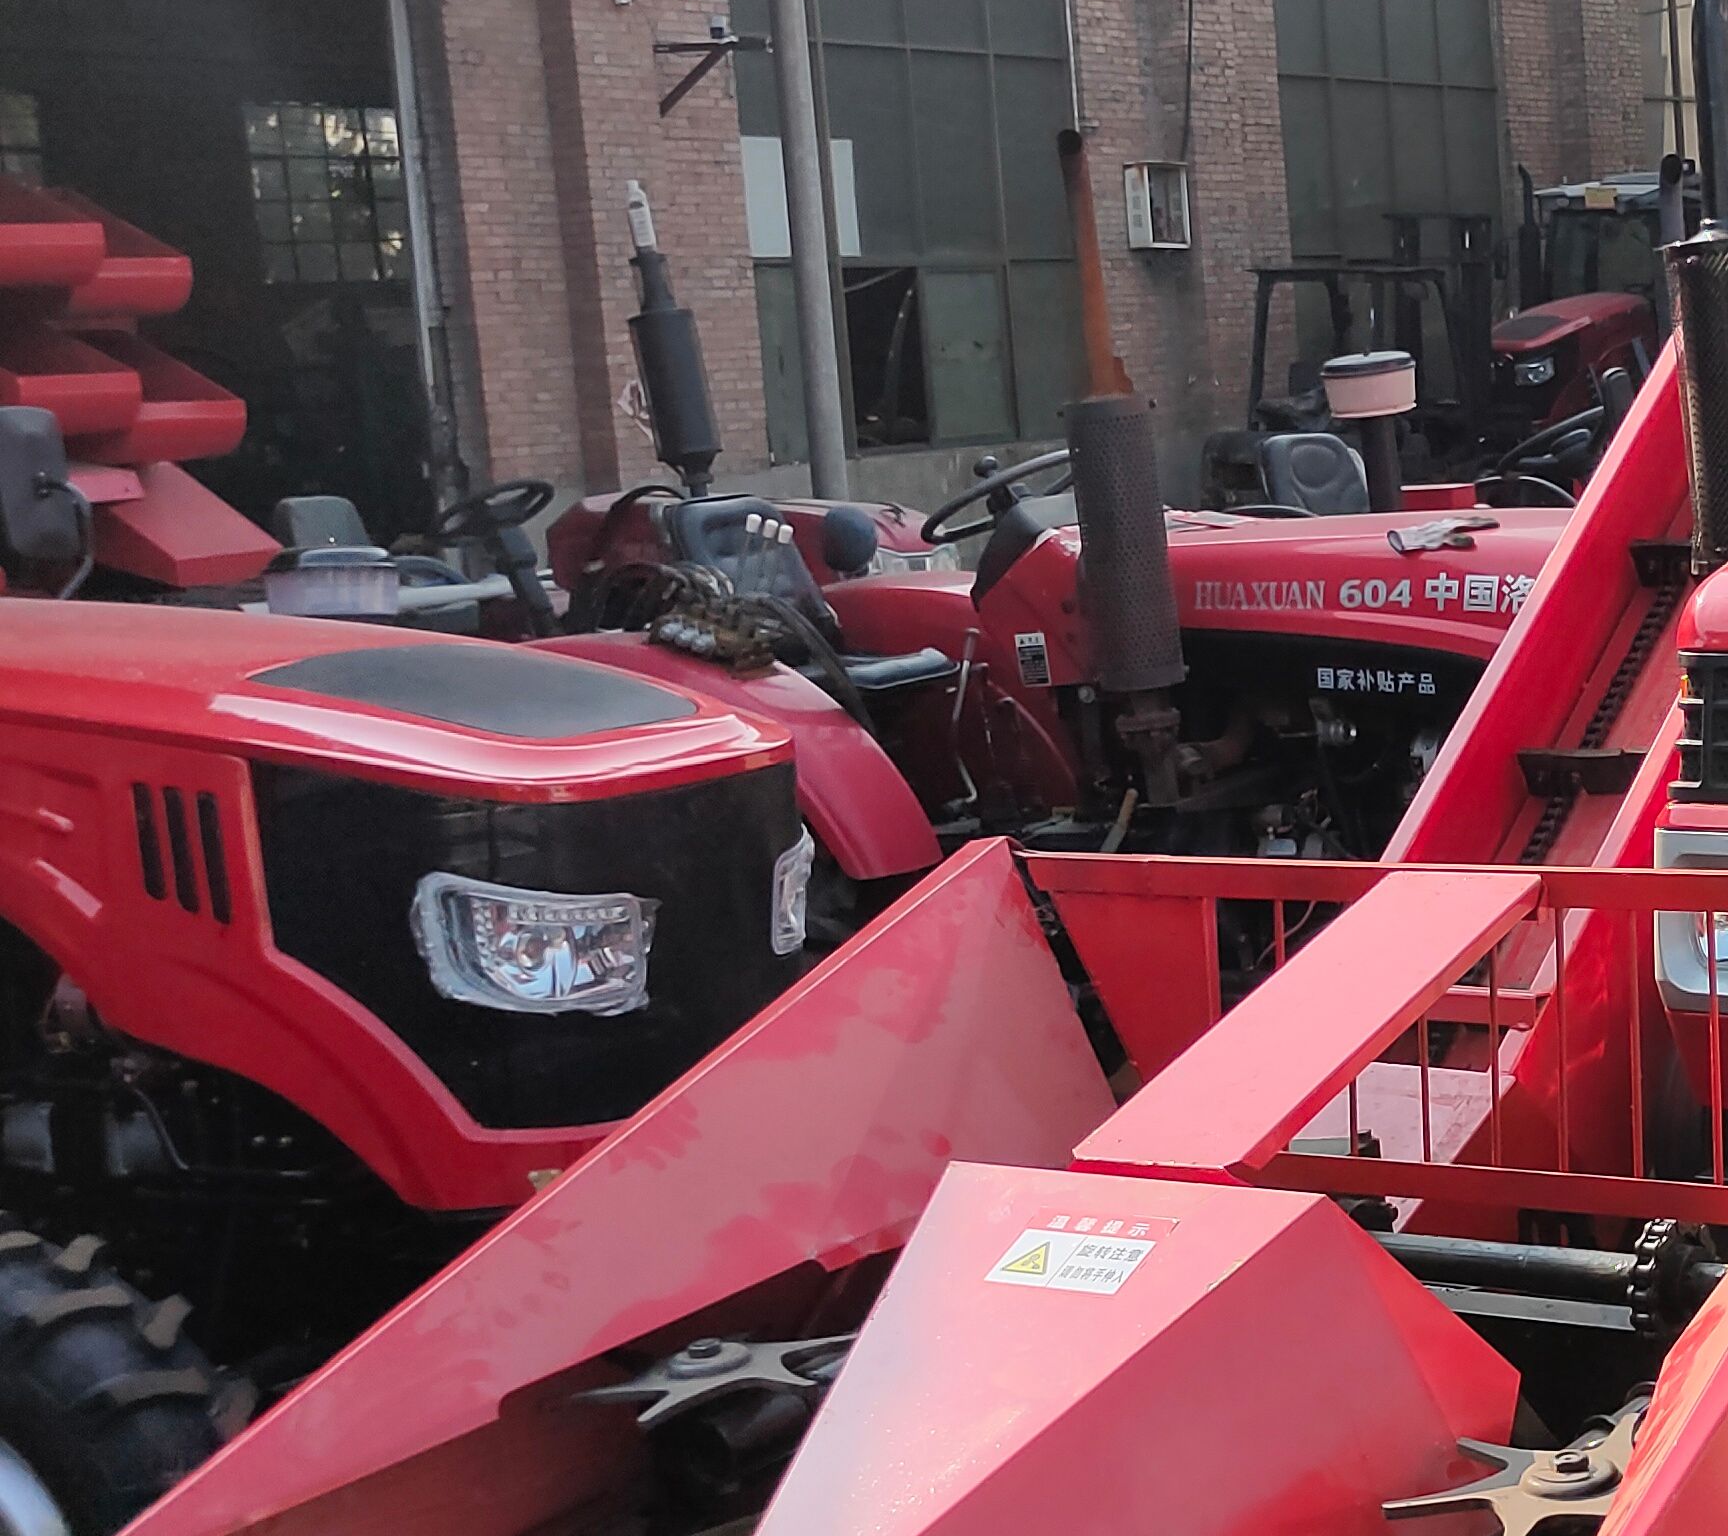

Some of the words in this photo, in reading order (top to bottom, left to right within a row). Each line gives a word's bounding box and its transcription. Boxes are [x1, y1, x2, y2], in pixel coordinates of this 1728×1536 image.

[1194, 579, 1326, 611] HUAXUAN
[1338, 578, 1412, 609] 604
[1317, 667, 1436, 695] 国家补贴产品
[1046, 1215, 1151, 1237] 温馨提示
